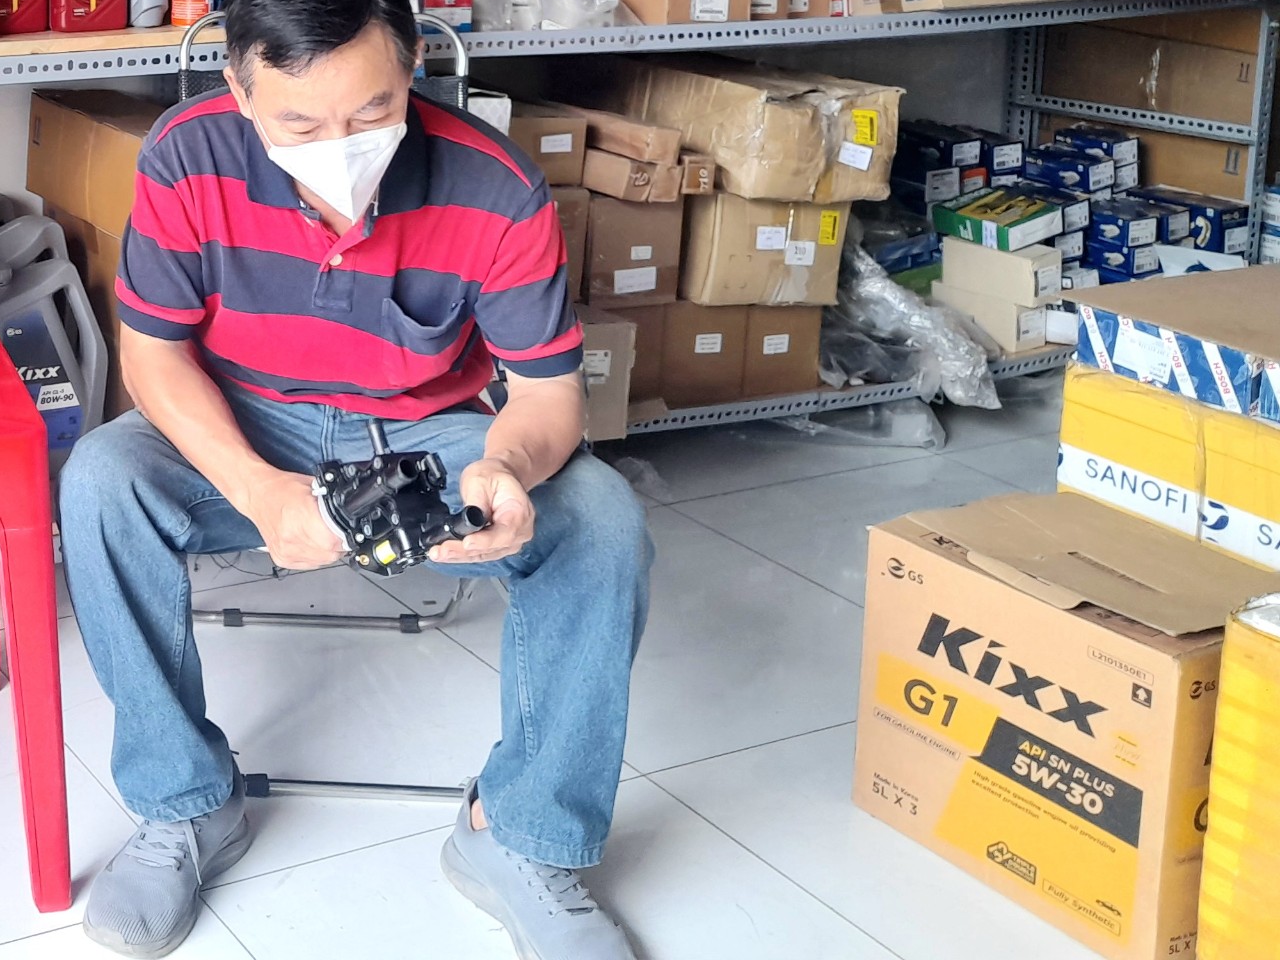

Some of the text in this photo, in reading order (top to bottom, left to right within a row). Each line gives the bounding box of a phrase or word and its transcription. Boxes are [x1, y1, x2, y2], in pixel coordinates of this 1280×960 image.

[40, 393, 74, 405] 80W-90
[1213, 362, 1230, 395] BOSCH
[1085, 457, 1188, 514] SANOFI
[907, 570, 924, 585] GS
[916, 612, 1109, 740] Kixx
[1204, 680, 1216, 692] GS
[903, 678, 959, 728] G1
[891, 717, 928, 743] GASOLINE
[928, 736, 958, 758] ENGINE
[1011, 753, 1104, 816] 5W-30
[1018, 740, 1116, 799] API SN PLUS
[871, 781, 889, 800] 5L
[908, 802, 919, 817] 3
[1047, 884, 1117, 930] Fully Synthetic
[1168, 943, 1180, 955] 5L
